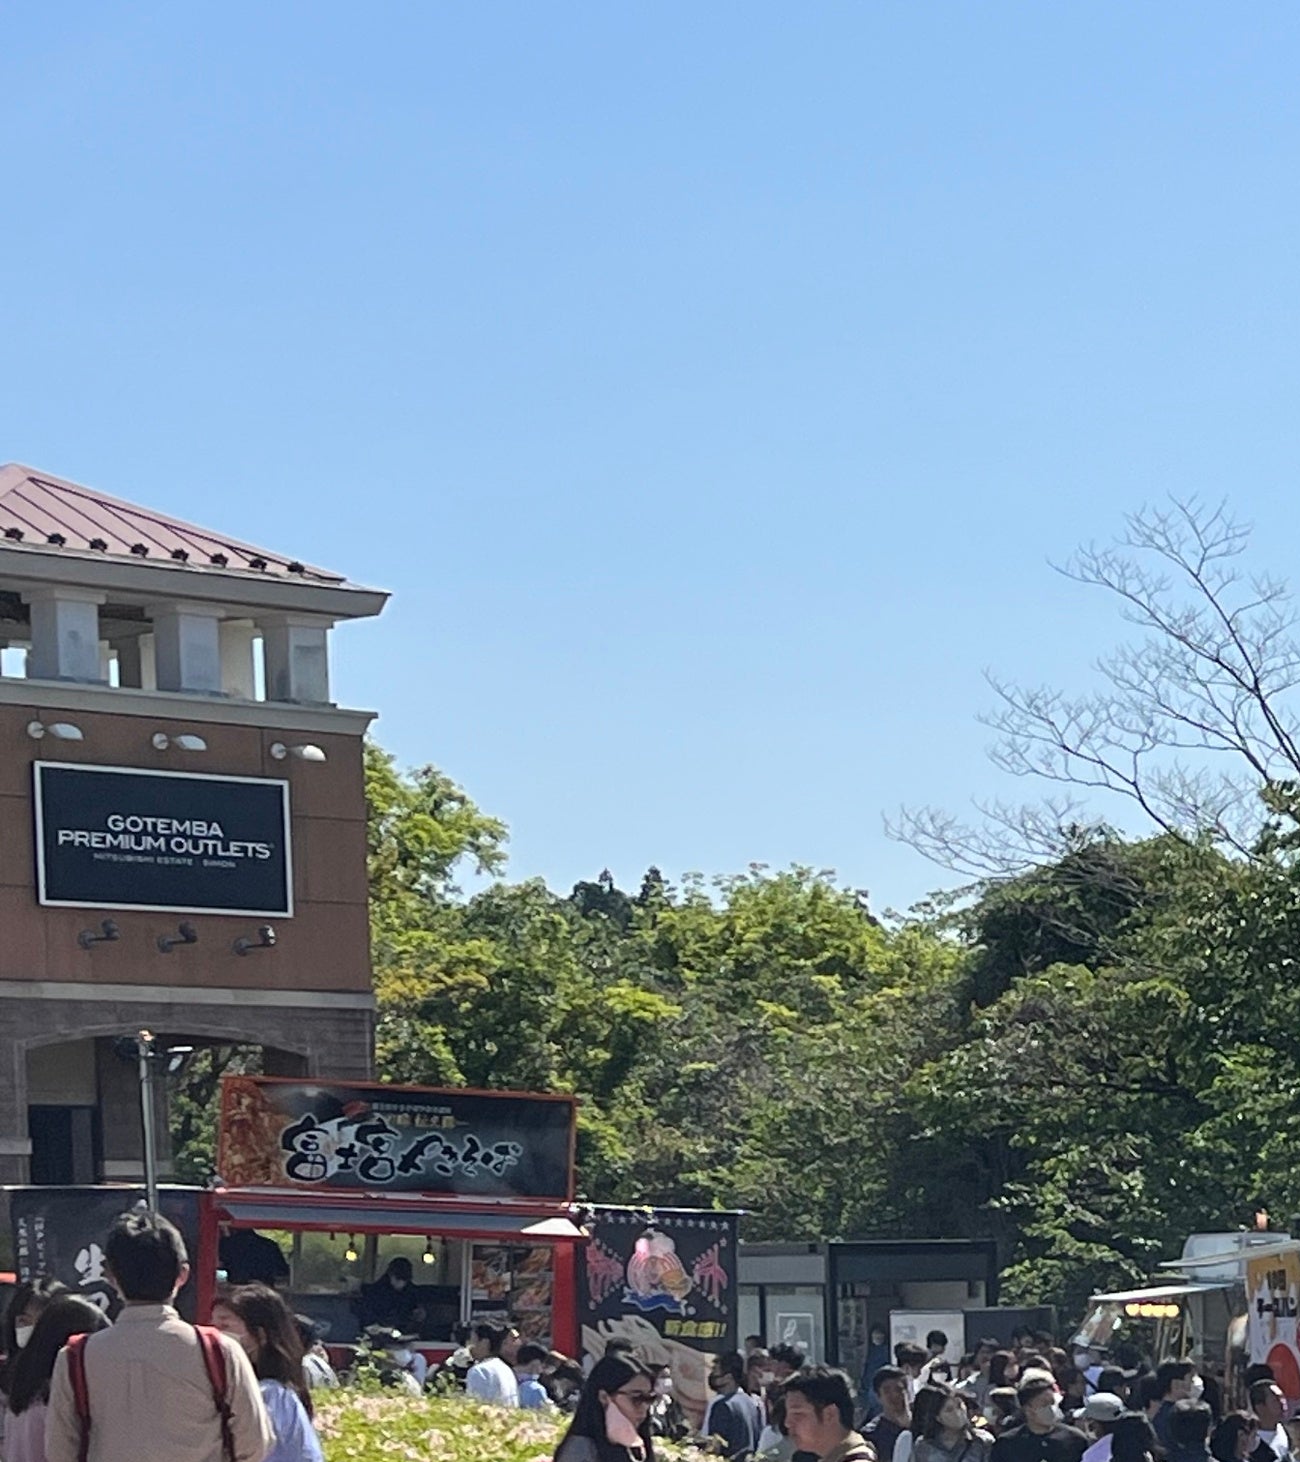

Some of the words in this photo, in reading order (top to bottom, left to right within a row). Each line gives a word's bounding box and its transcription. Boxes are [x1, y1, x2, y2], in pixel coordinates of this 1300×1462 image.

[107, 814, 224, 838] GOTEMBA
[57, 829, 166, 852] PREMIUM
[170, 837, 271, 859] OUTLETS
[156, 855, 194, 867] ESTATE
[280, 1113, 523, 1184] 富士宮やきそば
